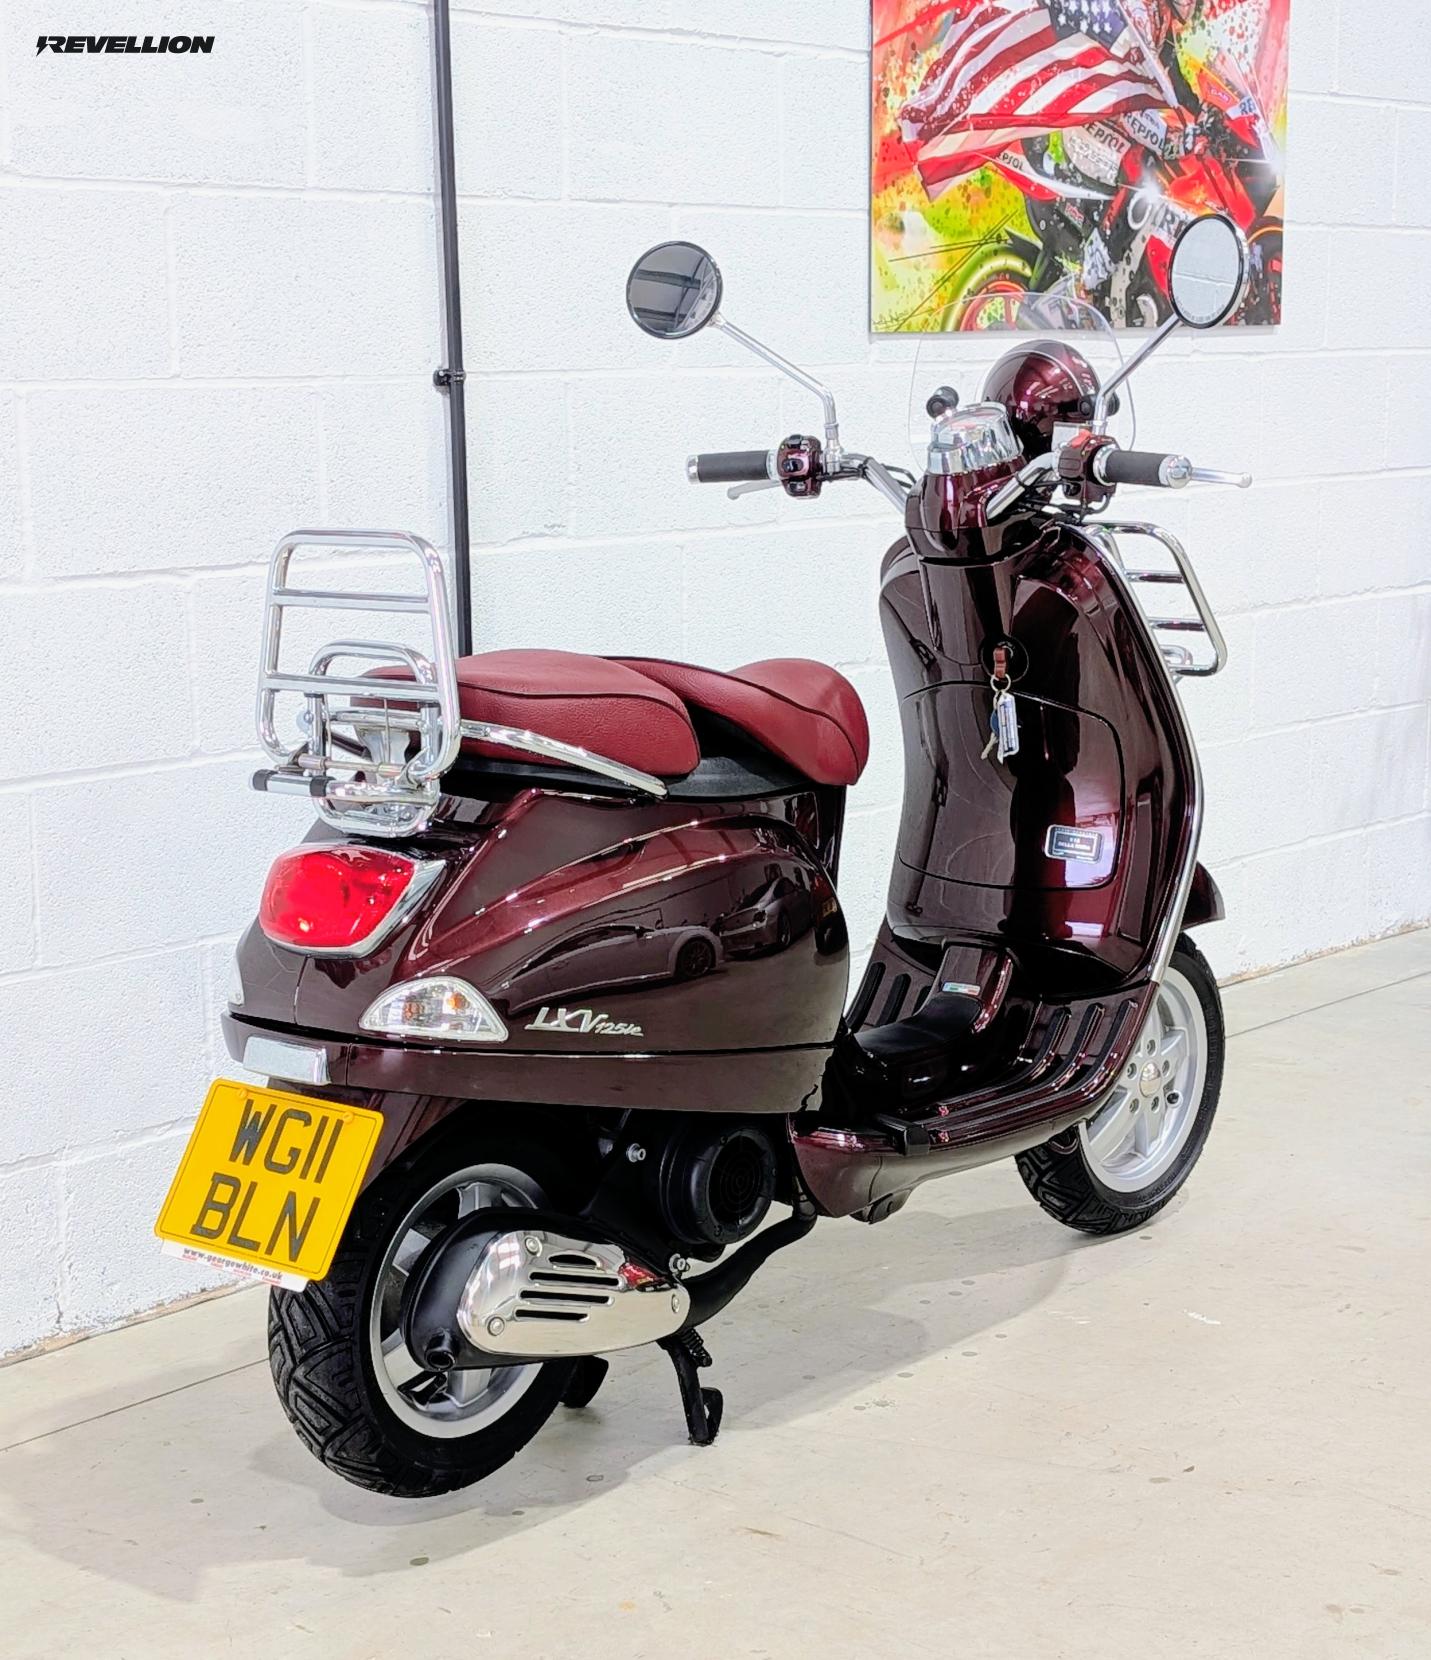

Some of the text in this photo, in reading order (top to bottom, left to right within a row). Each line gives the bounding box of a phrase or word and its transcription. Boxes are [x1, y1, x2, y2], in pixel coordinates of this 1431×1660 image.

[1082, 121, 1127, 154] EPSOL
[229, 1098, 344, 1184] WG11
[190, 1171, 321, 1263] BLN
[183, 1247, 283, 1280] www.georgewhite.co.uk
